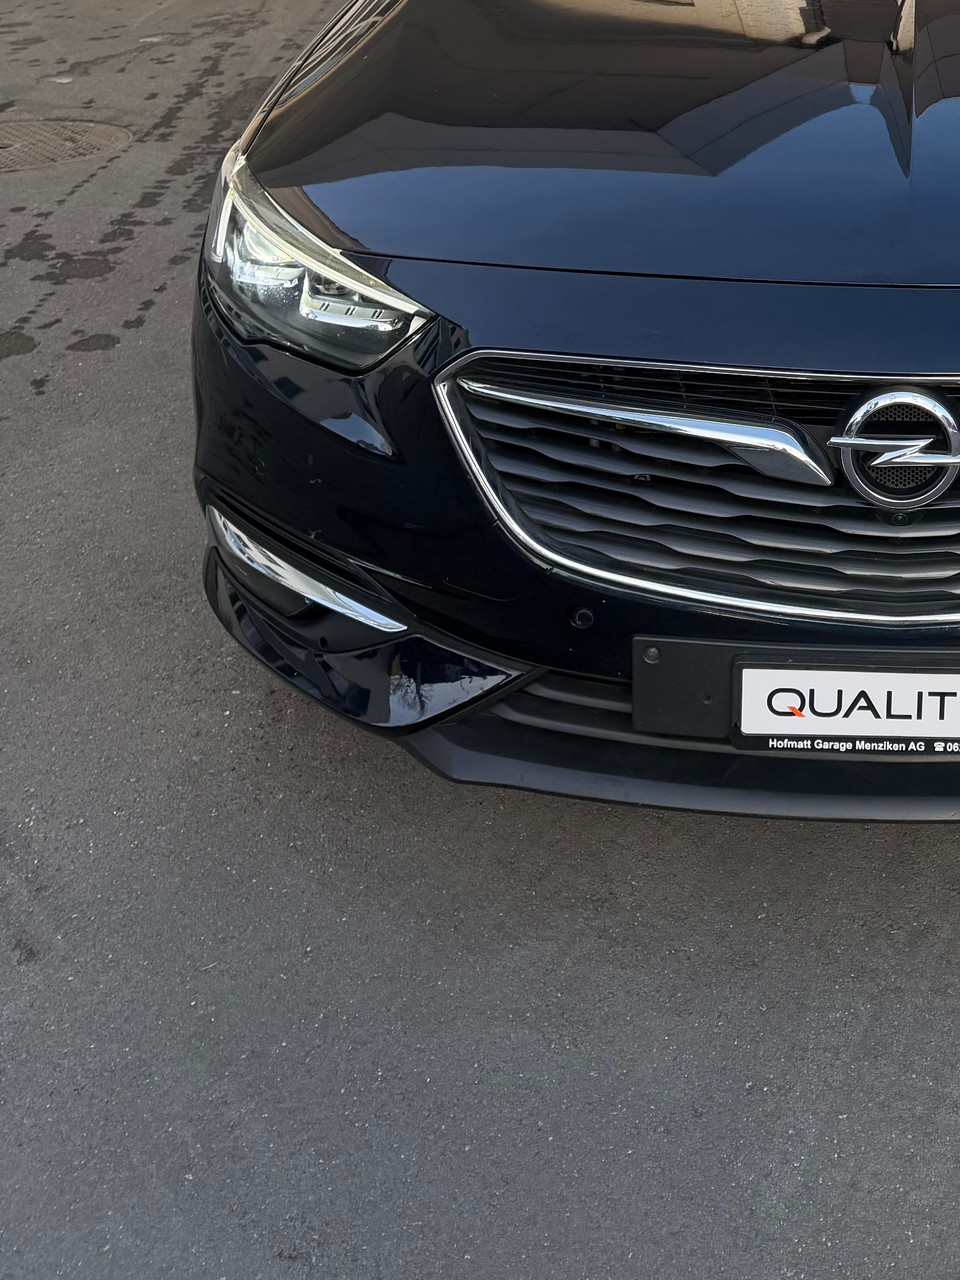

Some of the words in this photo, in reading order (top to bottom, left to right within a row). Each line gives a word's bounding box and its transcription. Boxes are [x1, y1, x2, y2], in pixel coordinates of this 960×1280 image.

[768, 738, 812, 750] Hofmatt
[813, 739, 853, 752] Garage
[855, 740, 906, 752] Menziken
[908, 742, 925, 752] AG
